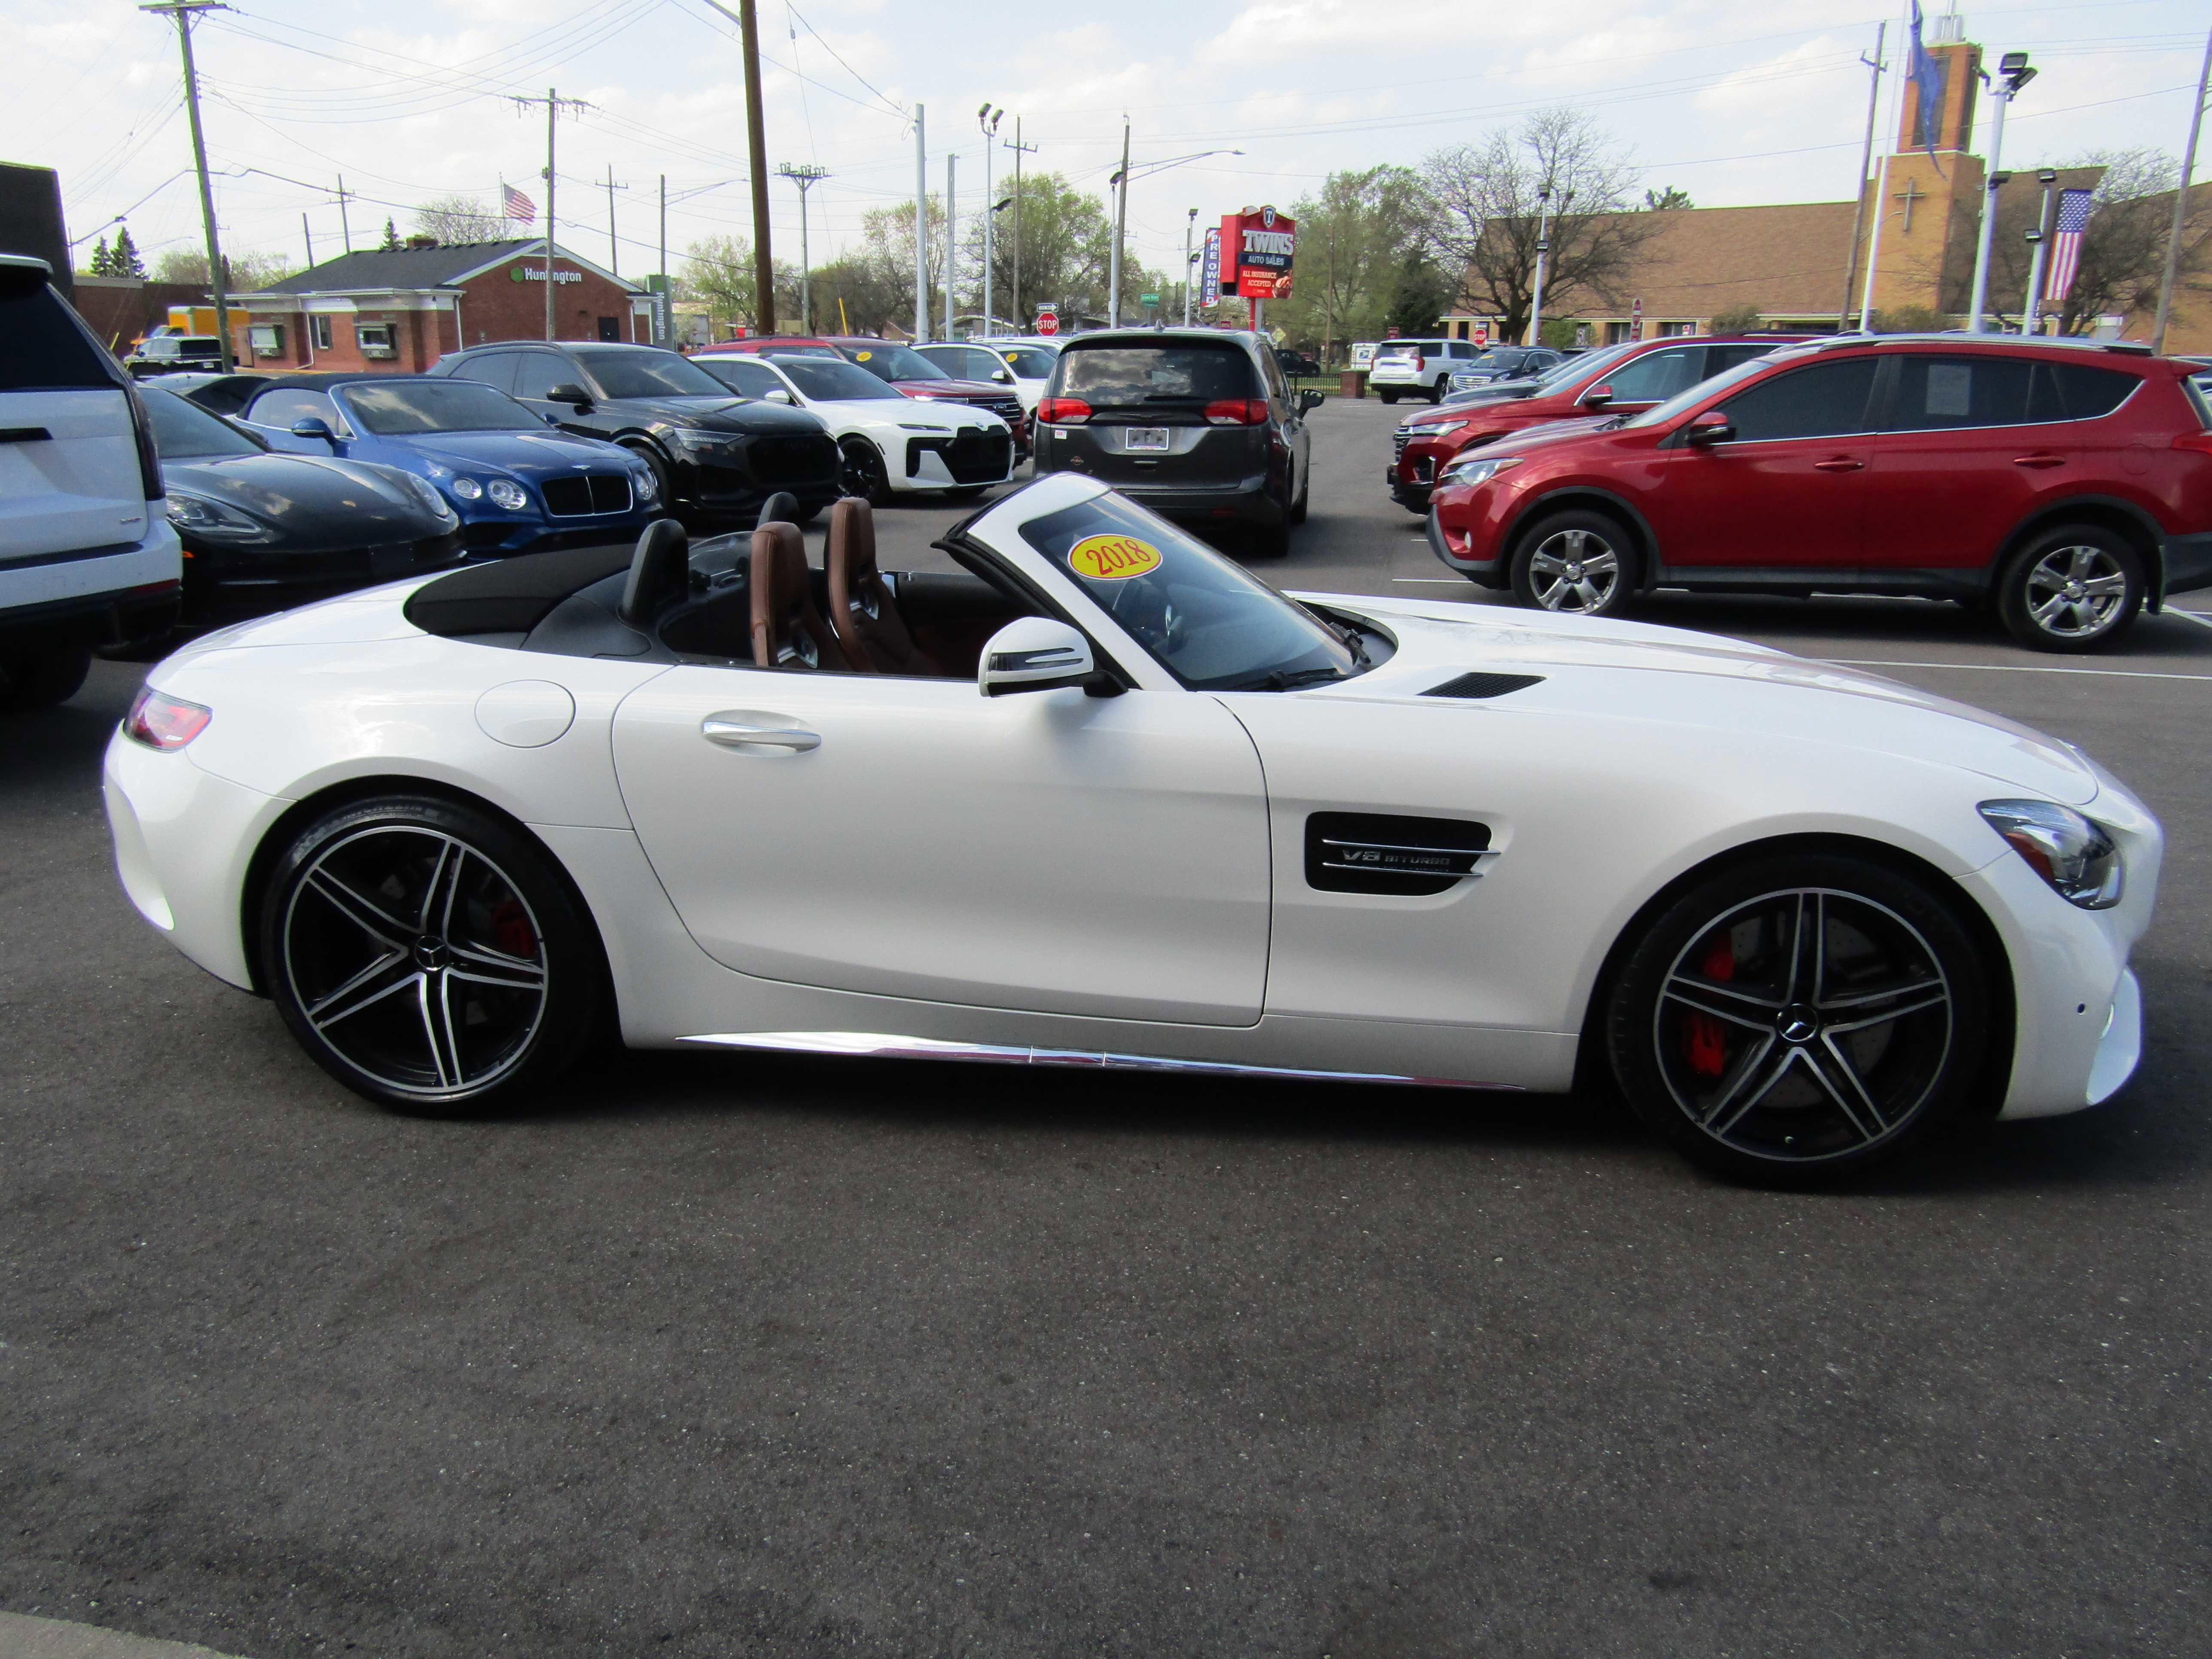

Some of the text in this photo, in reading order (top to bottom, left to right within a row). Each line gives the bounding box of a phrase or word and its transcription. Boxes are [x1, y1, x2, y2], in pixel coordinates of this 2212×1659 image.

[1242, 229, 1294, 256] TWINS
[1206, 235, 1218, 304] PRE OWNED
[1248, 255, 1285, 266] AUTO SALES
[656, 292, 665, 340] Huntington
[1038, 319, 1057, 330] STOP
[1086, 540, 1151, 575] 2018
[1343, 849, 1381, 862] V8
